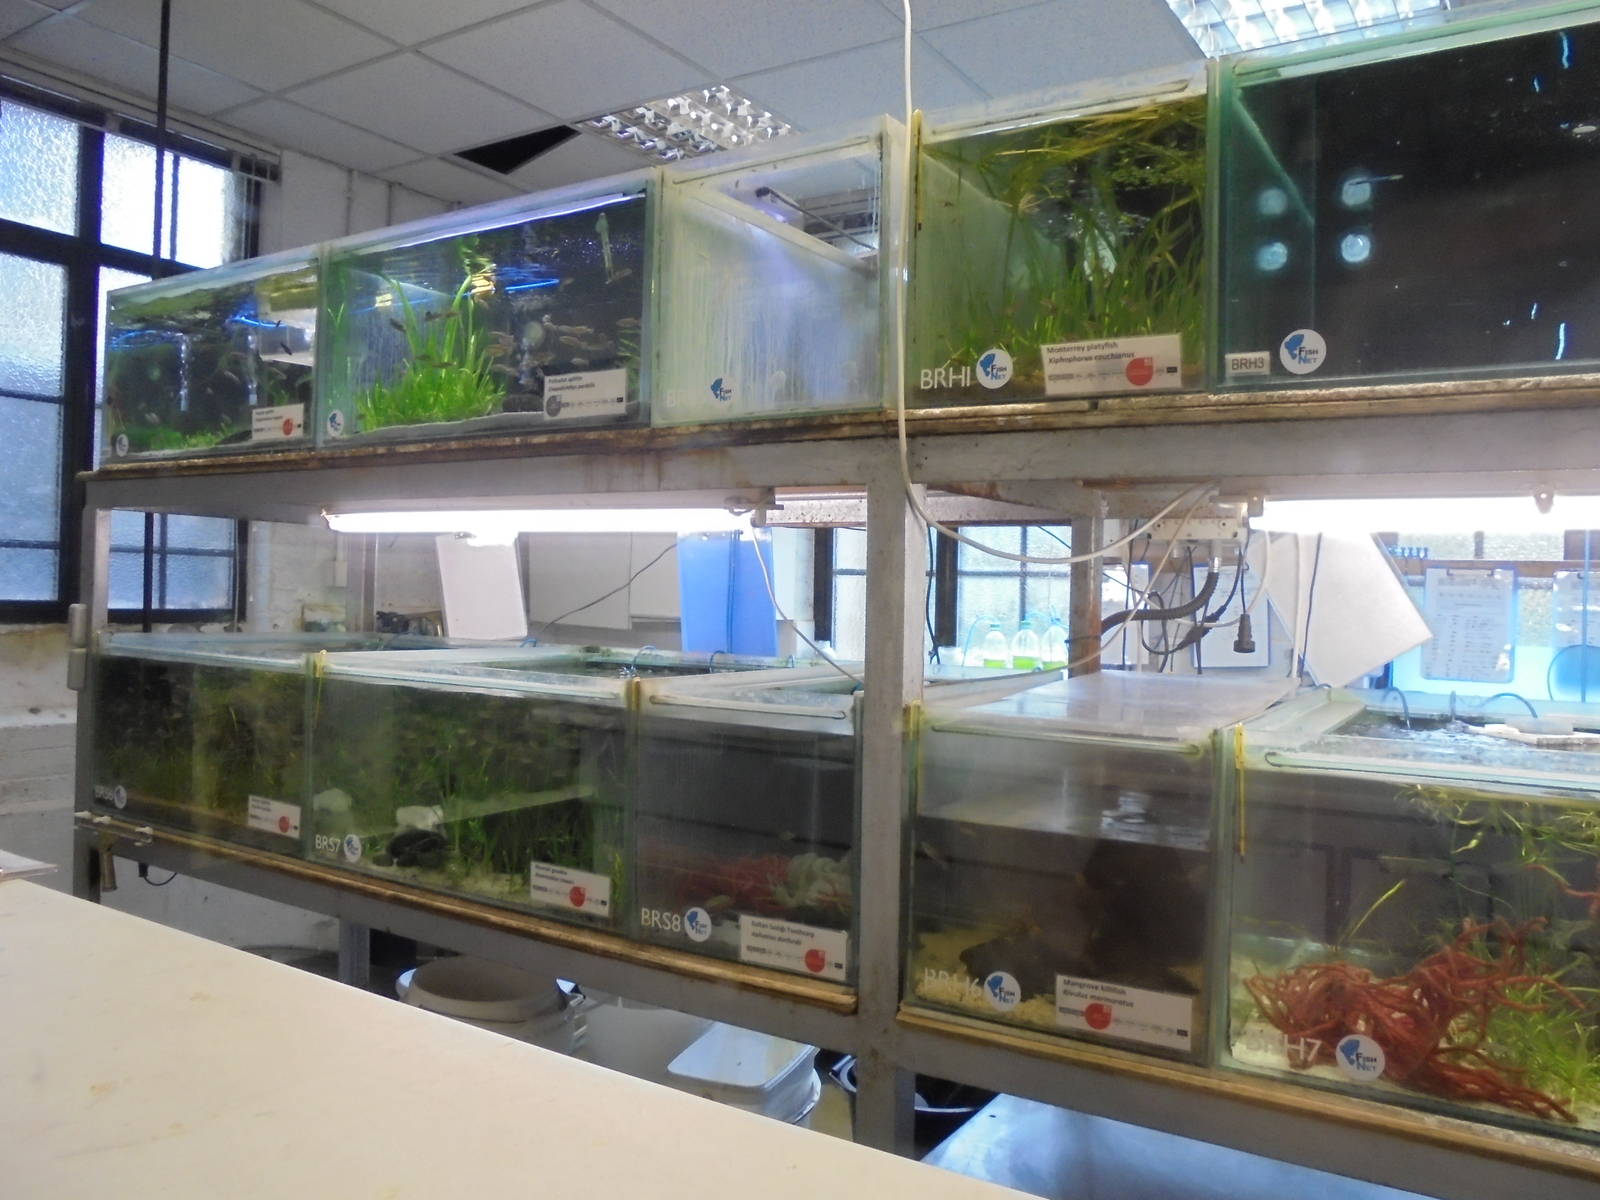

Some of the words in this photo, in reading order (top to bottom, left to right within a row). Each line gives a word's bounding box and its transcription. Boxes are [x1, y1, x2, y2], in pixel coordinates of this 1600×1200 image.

[1231, 357, 1265, 371] BRH3
[315, 834, 341, 853] BRS7
[641, 908, 682, 932] BRS8
